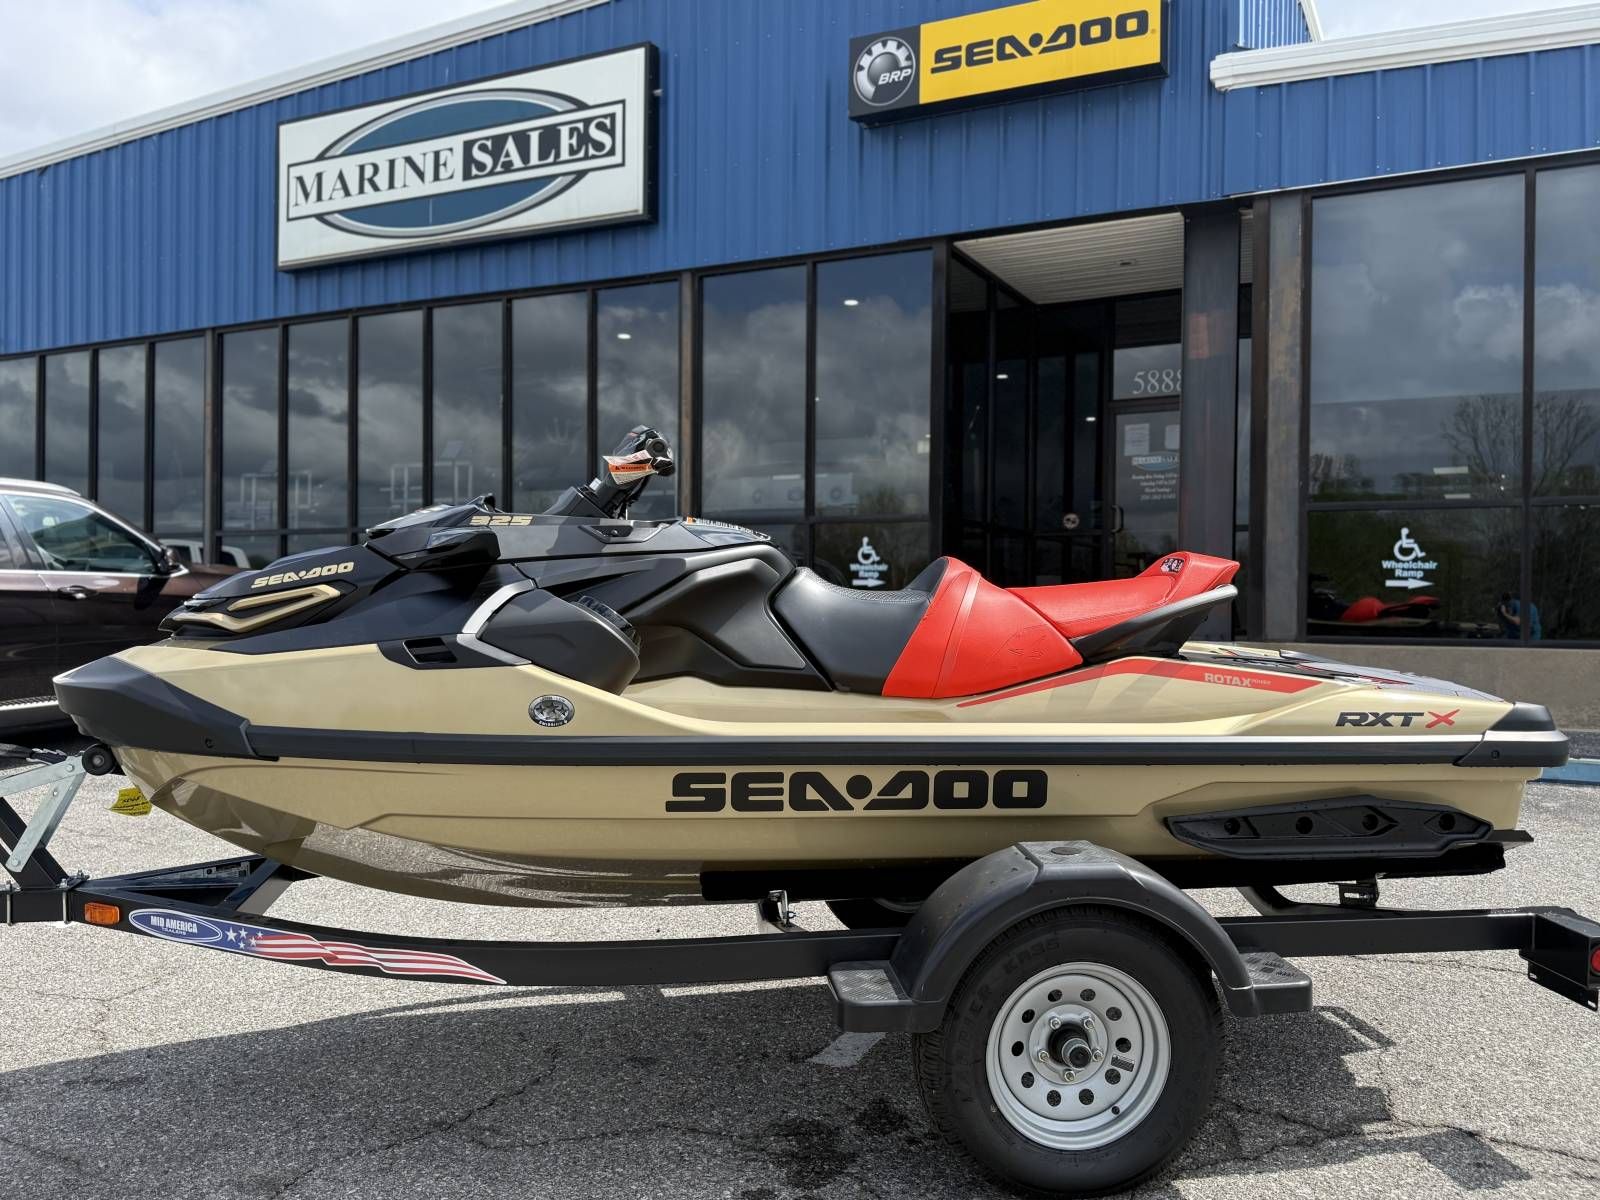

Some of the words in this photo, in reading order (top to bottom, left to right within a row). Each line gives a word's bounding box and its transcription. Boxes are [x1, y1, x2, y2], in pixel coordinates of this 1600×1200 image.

[878, 67, 912, 86] BRP
[292, 147, 455, 208] MARINE
[470, 116, 615, 178] SALES
[469, 515, 533, 526] 325
[1381, 560, 1438, 569] Wheelchair
[1395, 569, 1424, 579] Ramp
[1204, 672, 1252, 688] ROTAX
[150, 915, 165, 927] MID
[165, 918, 198, 933] AMERICA
